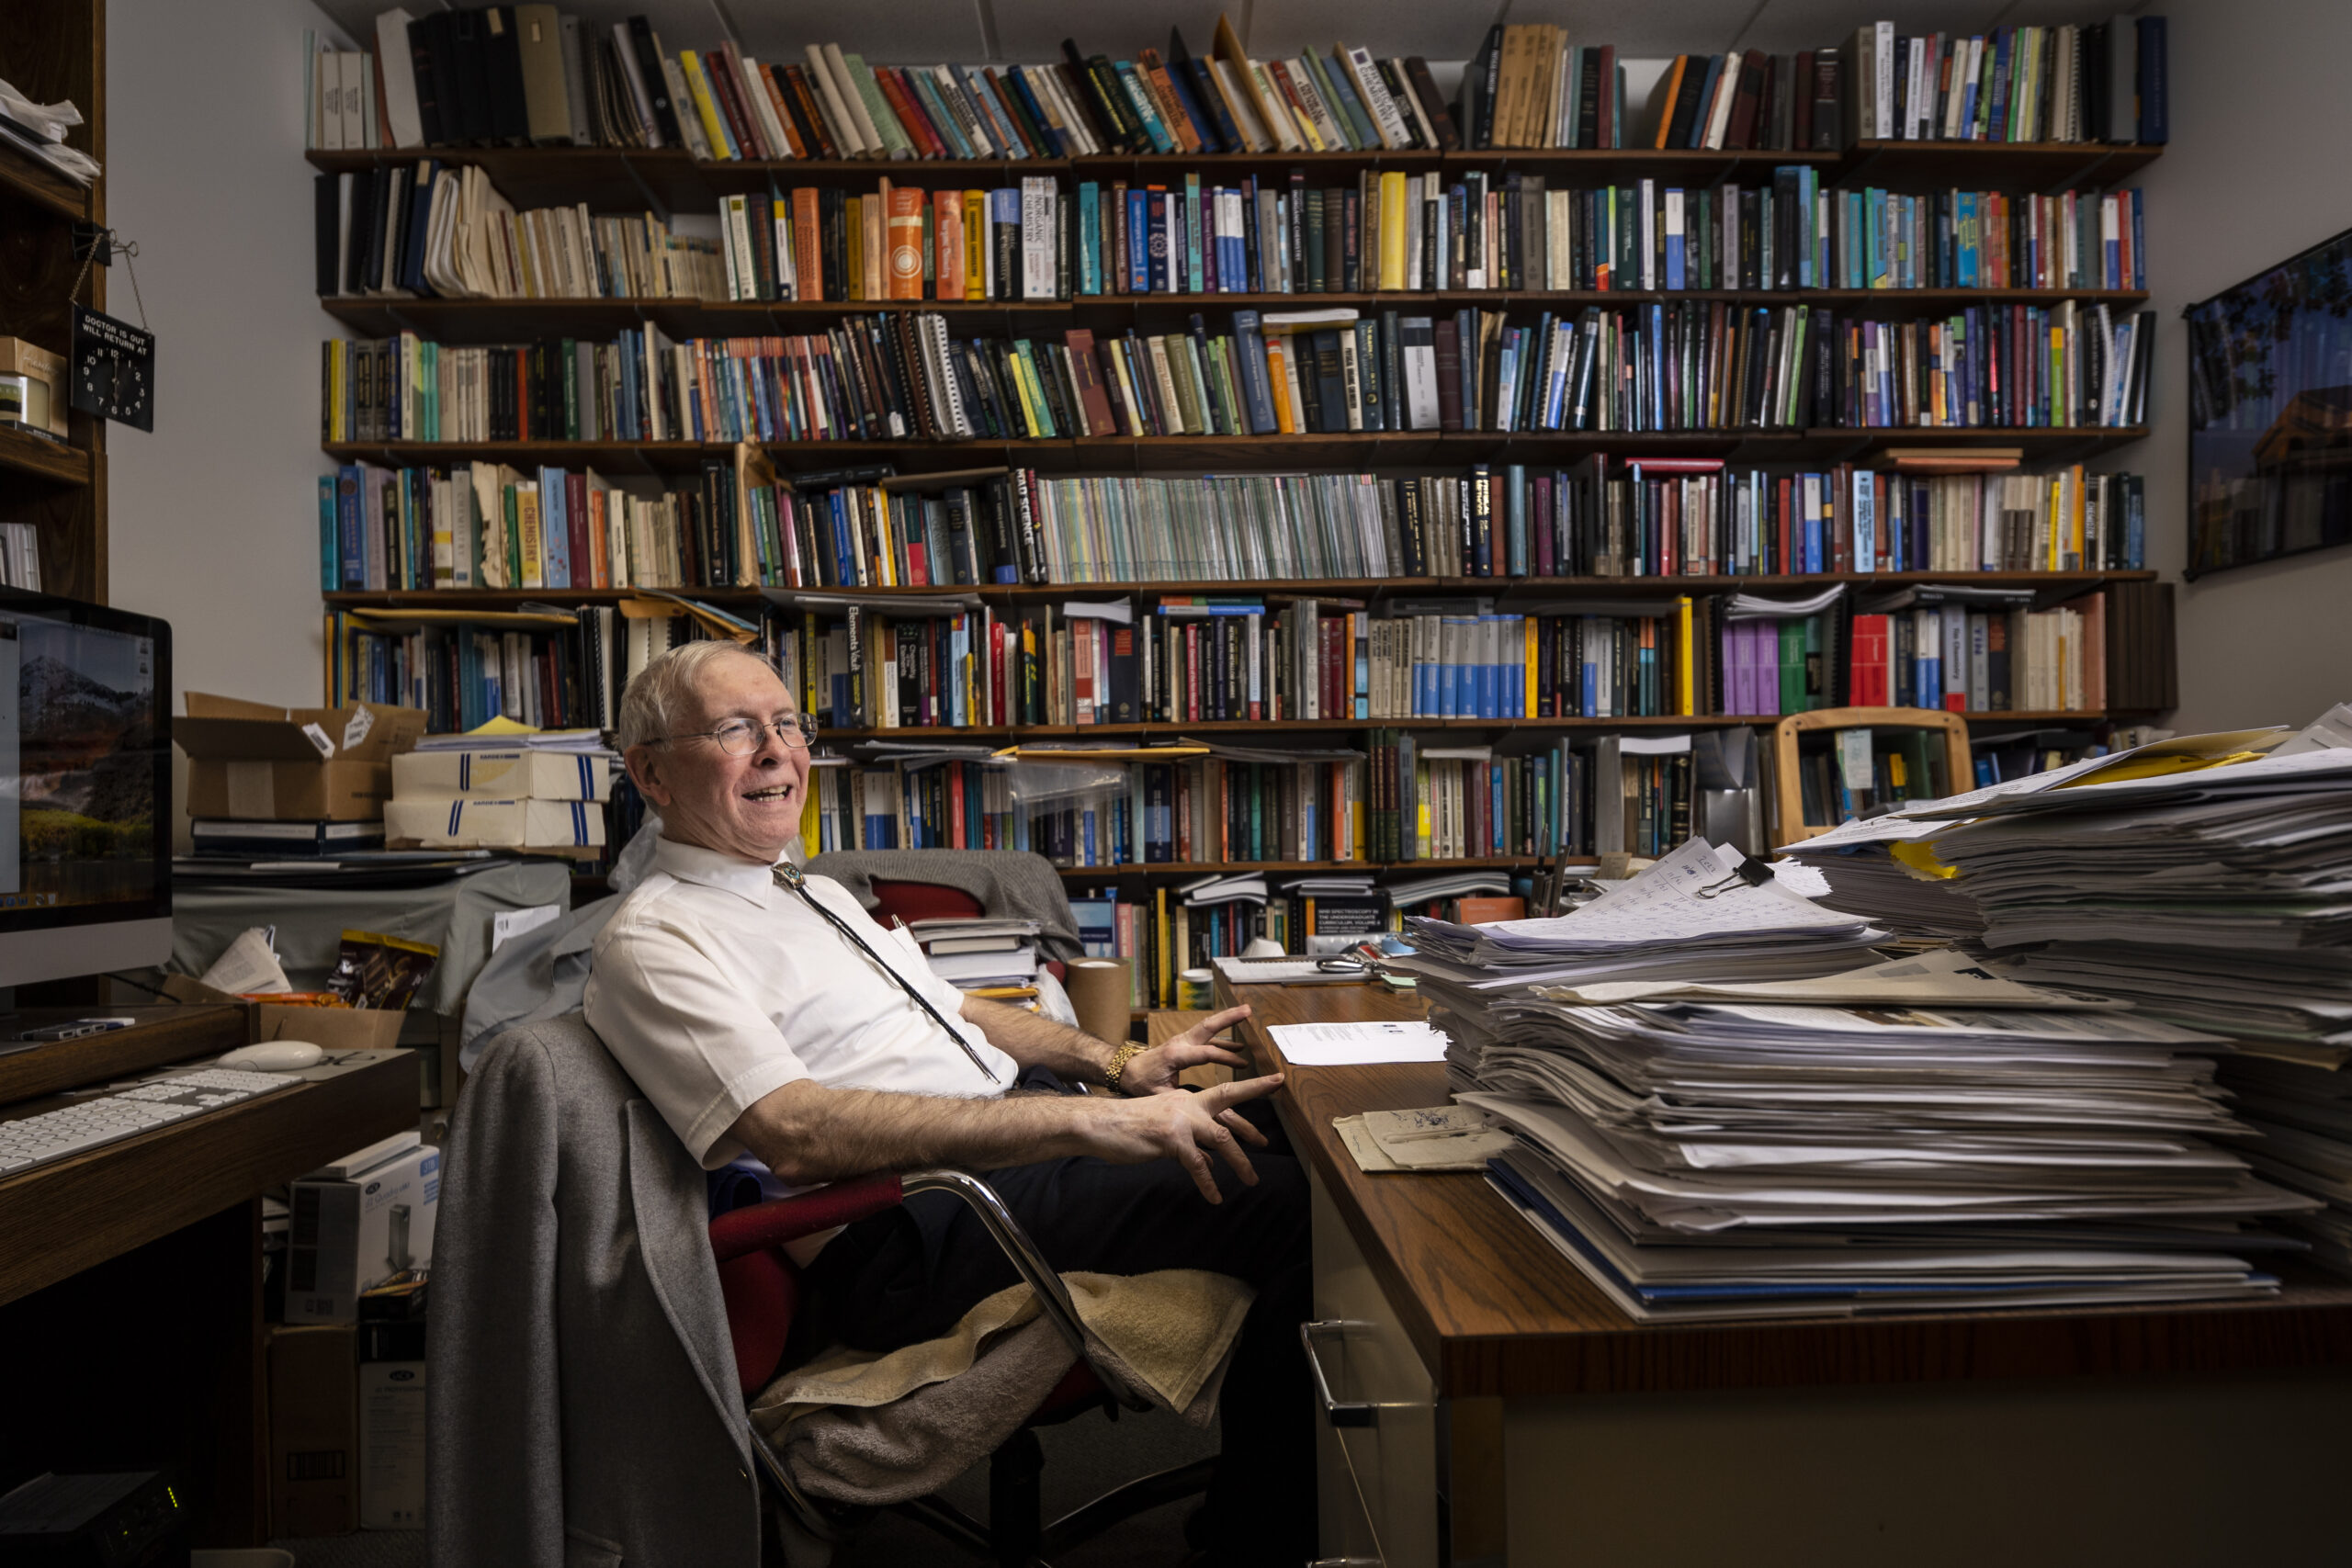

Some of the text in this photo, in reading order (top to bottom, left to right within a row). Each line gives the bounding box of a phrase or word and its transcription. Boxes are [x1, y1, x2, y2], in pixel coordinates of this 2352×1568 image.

[1360, 67, 1390, 121] CHEMISTRY
[1369, 64, 1397, 118] PHYSICAL
[1024, 194, 1035, 242] CHEMISTRY
[1035, 194, 1045, 243] INORGANIC
[1292, 198, 1300, 224] INORGANIC
[82, 323, 147, 356] WILL RETURN AT
[85, 314, 145, 346] DOCTOR IS OUT
[83, 367, 89, 376] 9
[87, 355, 96, 366] 10
[1345, 347, 1353, 367] PHYSICAL
[86, 382, 93, 392] 8
[135, 371, 141, 382] 2
[98, 397, 104, 407] 7
[139, 388, 145, 398] 3
[1348, 387, 1358, 410] CHEMISTRY
[111, 406, 118, 415] 6
[1016, 468, 1035, 546] MAD SCIENCE
[1027, 469, 1038, 522] MAD SCIENCE
[1475, 479, 1483, 515] METHODS
[457, 491, 465, 556] CHEMISTRY
[524, 506, 537, 561] CHEMISTRY
[849, 606, 861, 671] Elements Vault
[1974, 626, 1984, 655] TIN
[908, 644, 917, 679] Chemistry
